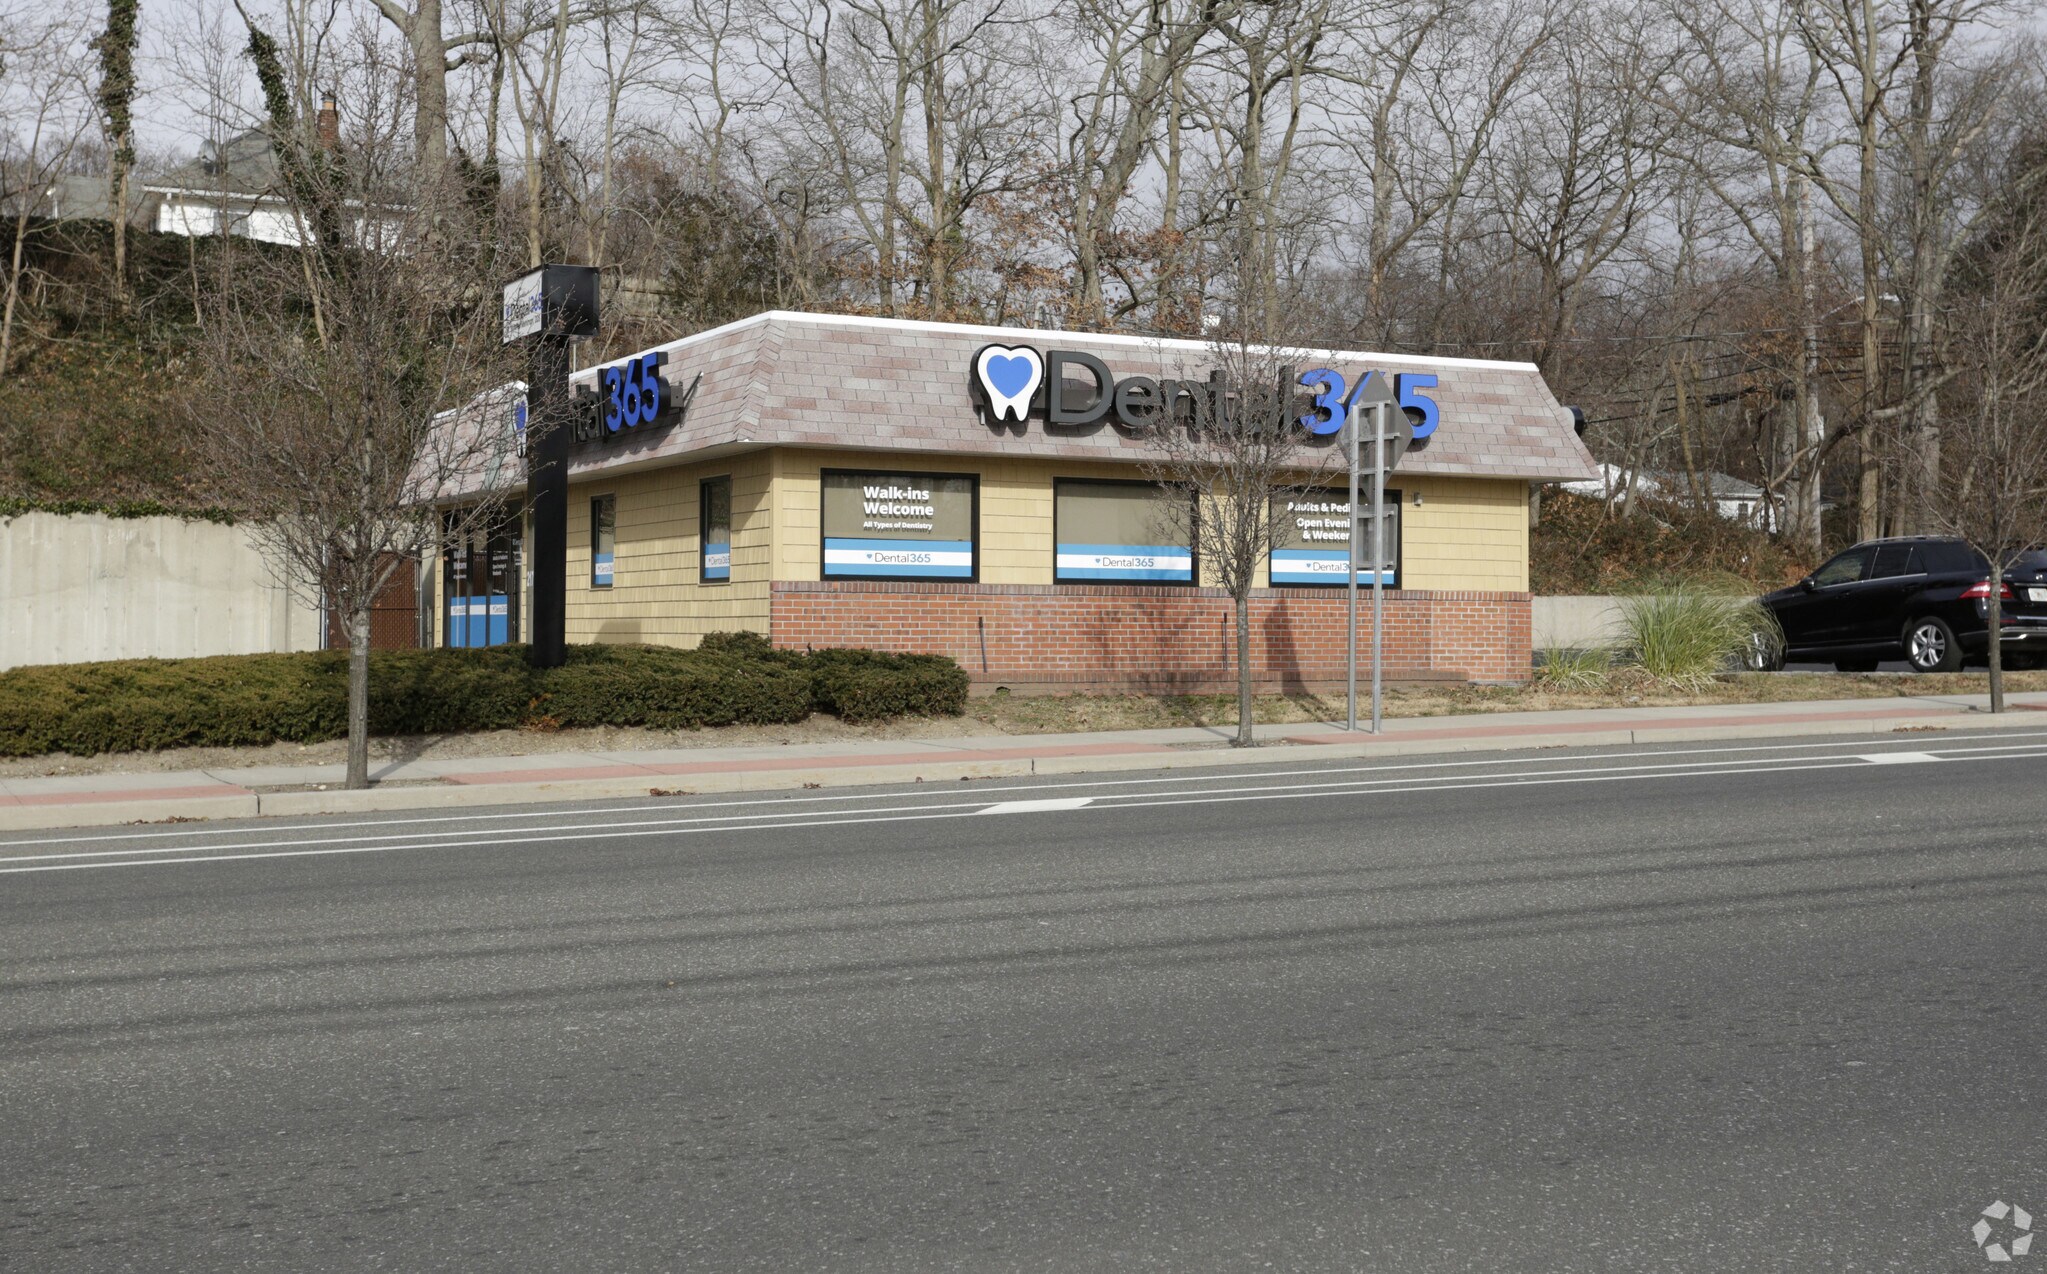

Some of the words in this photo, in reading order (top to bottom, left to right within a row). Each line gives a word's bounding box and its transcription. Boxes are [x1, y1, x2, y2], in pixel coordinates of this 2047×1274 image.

[1046, 350, 1440, 440] Dental35
[863, 486, 930, 500] Walk-ins
[863, 502, 934, 516] Welcome
[1320, 503, 1329, 512] &
[1330, 502, 1350, 513] Pedi
[873, 522, 893, 530] Types
[902, 523, 933, 531] Dentistry
[1296, 518, 1323, 529] Open
[1324, 518, 1350, 528] Eveni
[1302, 530, 1311, 540] &
[875, 552, 931, 563] Dental365
[1102, 557, 1155, 567] Dental365
[1313, 562, 1348, 571] Dental3
